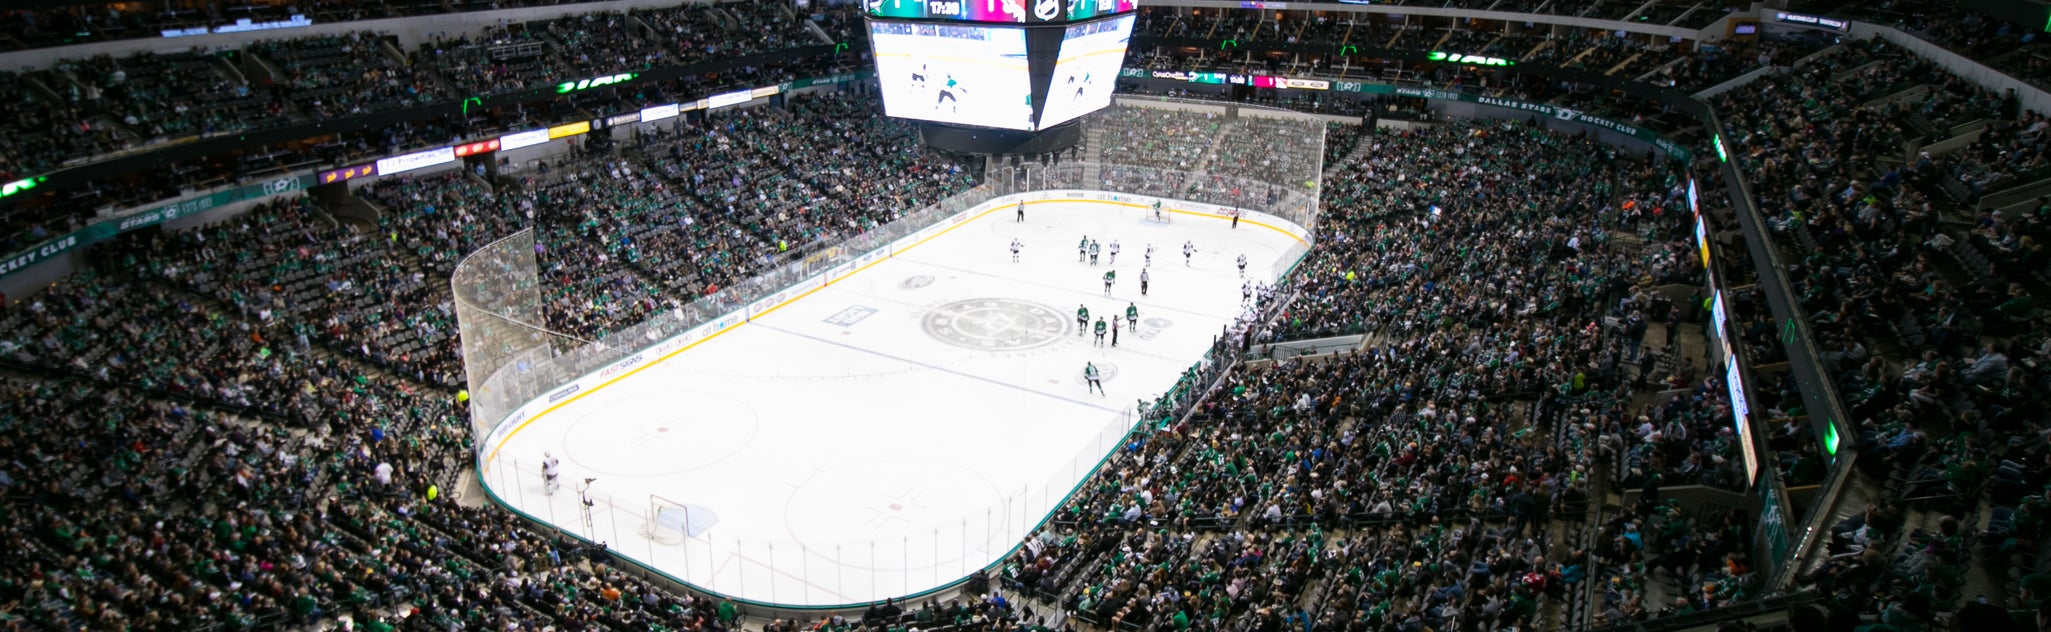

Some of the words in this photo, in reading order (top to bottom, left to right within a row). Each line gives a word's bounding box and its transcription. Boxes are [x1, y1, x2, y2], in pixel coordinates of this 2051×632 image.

[1478, 96, 1518, 110] DALLAS
[1520, 102, 1551, 114] STARS
[1580, 115, 1614, 129] HOCKEY
[1616, 123, 1637, 135] CLUB
[120, 212, 160, 230] STARS
[41, 236, 76, 257] CLUB
[702, 325, 711, 337] at
[712, 315, 738, 332] home
[600, 353, 642, 379] FASTSIGNS
[508, 411, 526, 428] LIGHT
